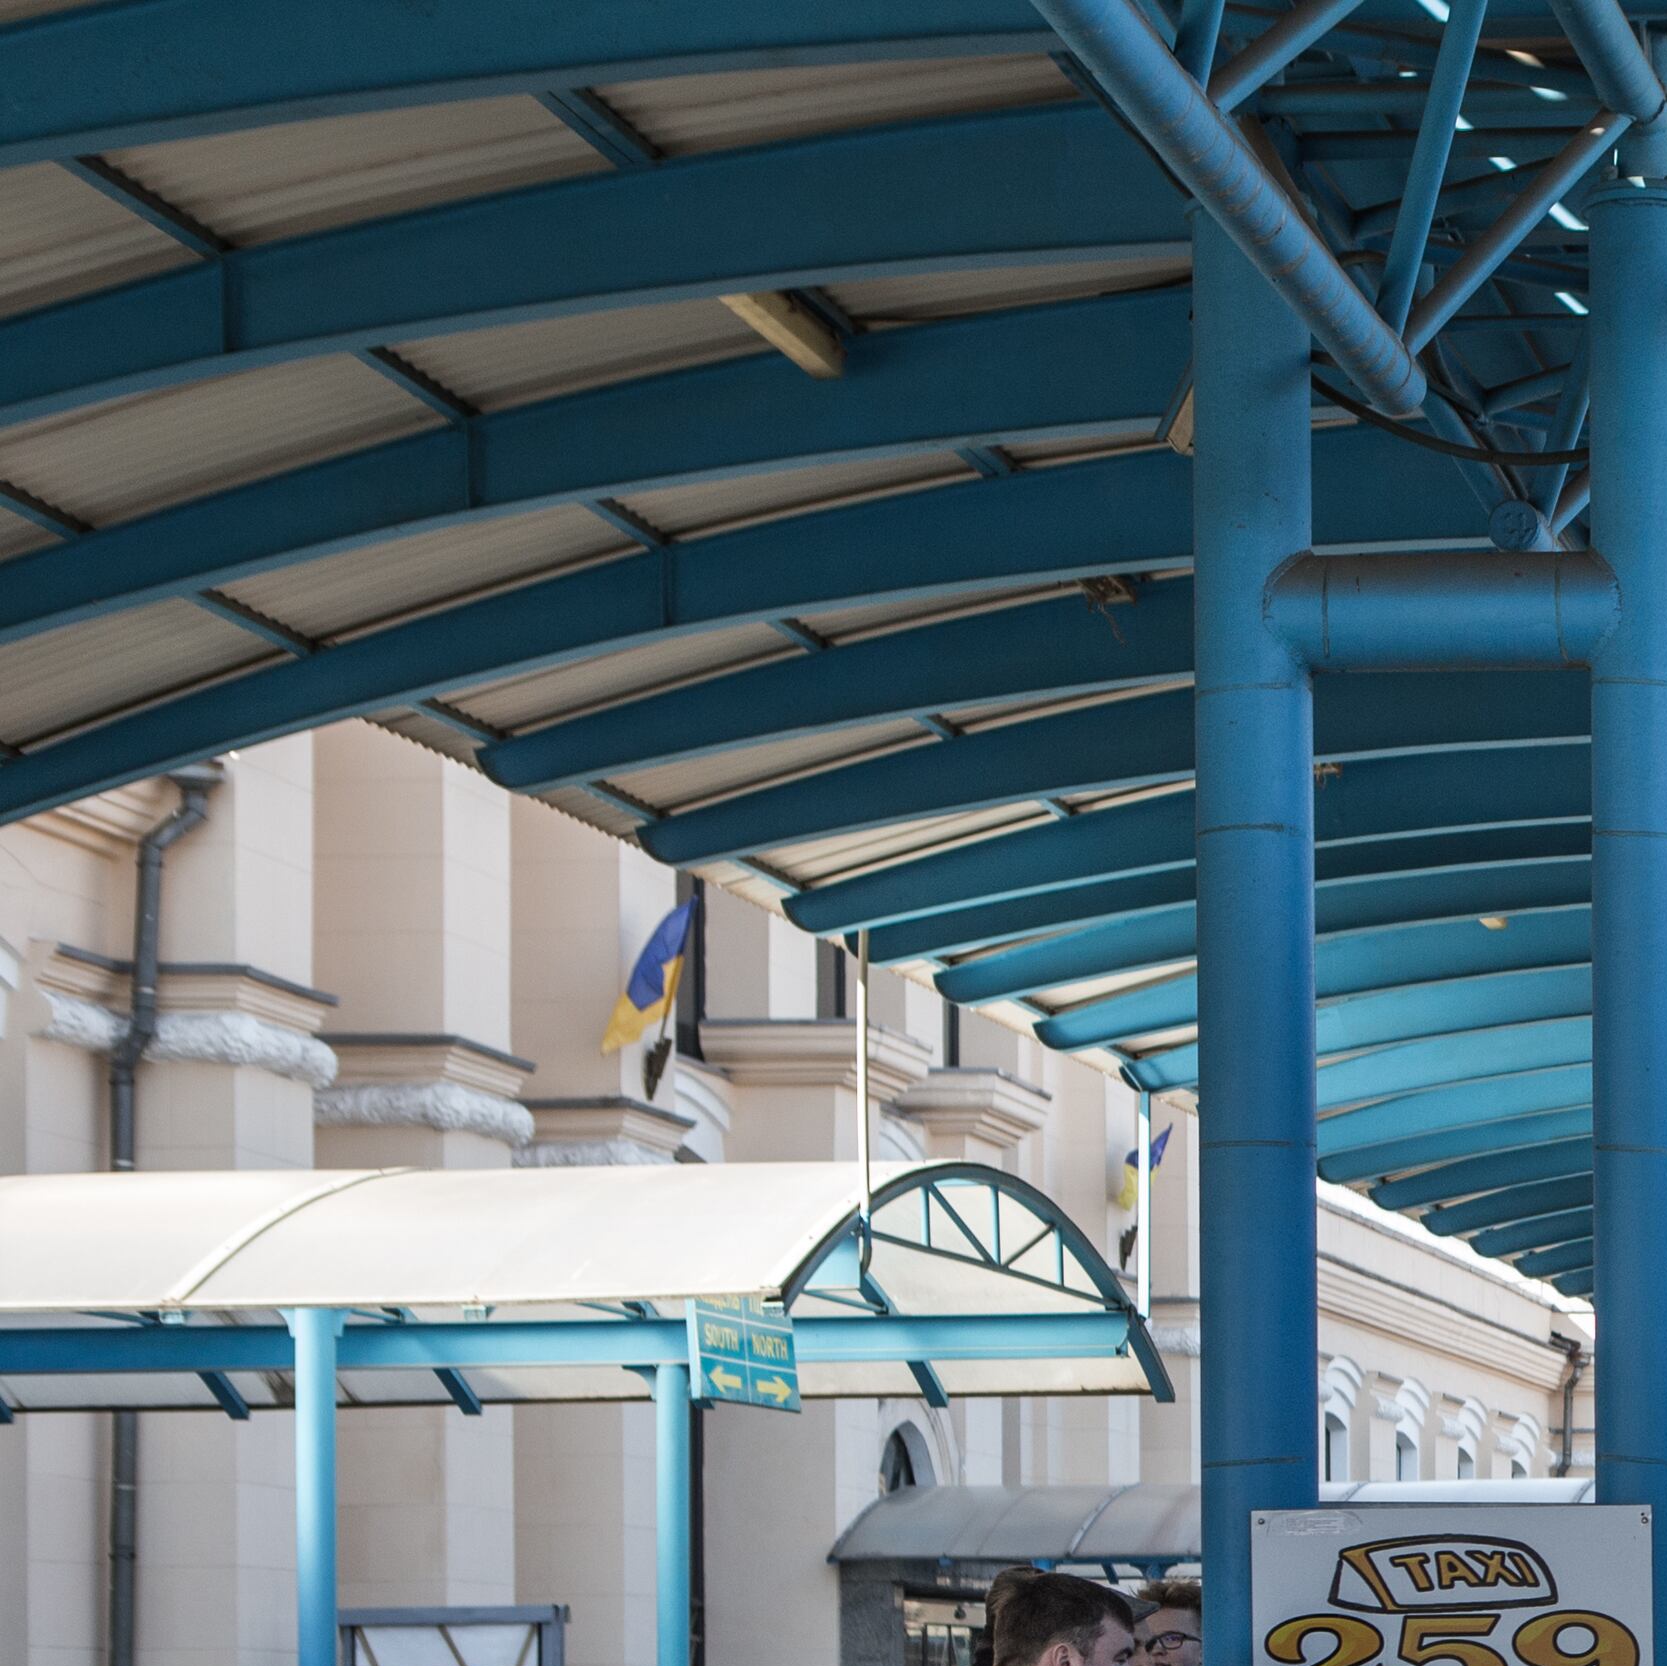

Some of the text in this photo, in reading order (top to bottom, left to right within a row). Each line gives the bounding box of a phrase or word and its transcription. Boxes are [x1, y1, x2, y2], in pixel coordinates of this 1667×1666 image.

[704, 1323, 740, 1351] SOUTH
[752, 1333, 788, 1361] NORTH
[1389, 1550, 1541, 1591] TAXI
